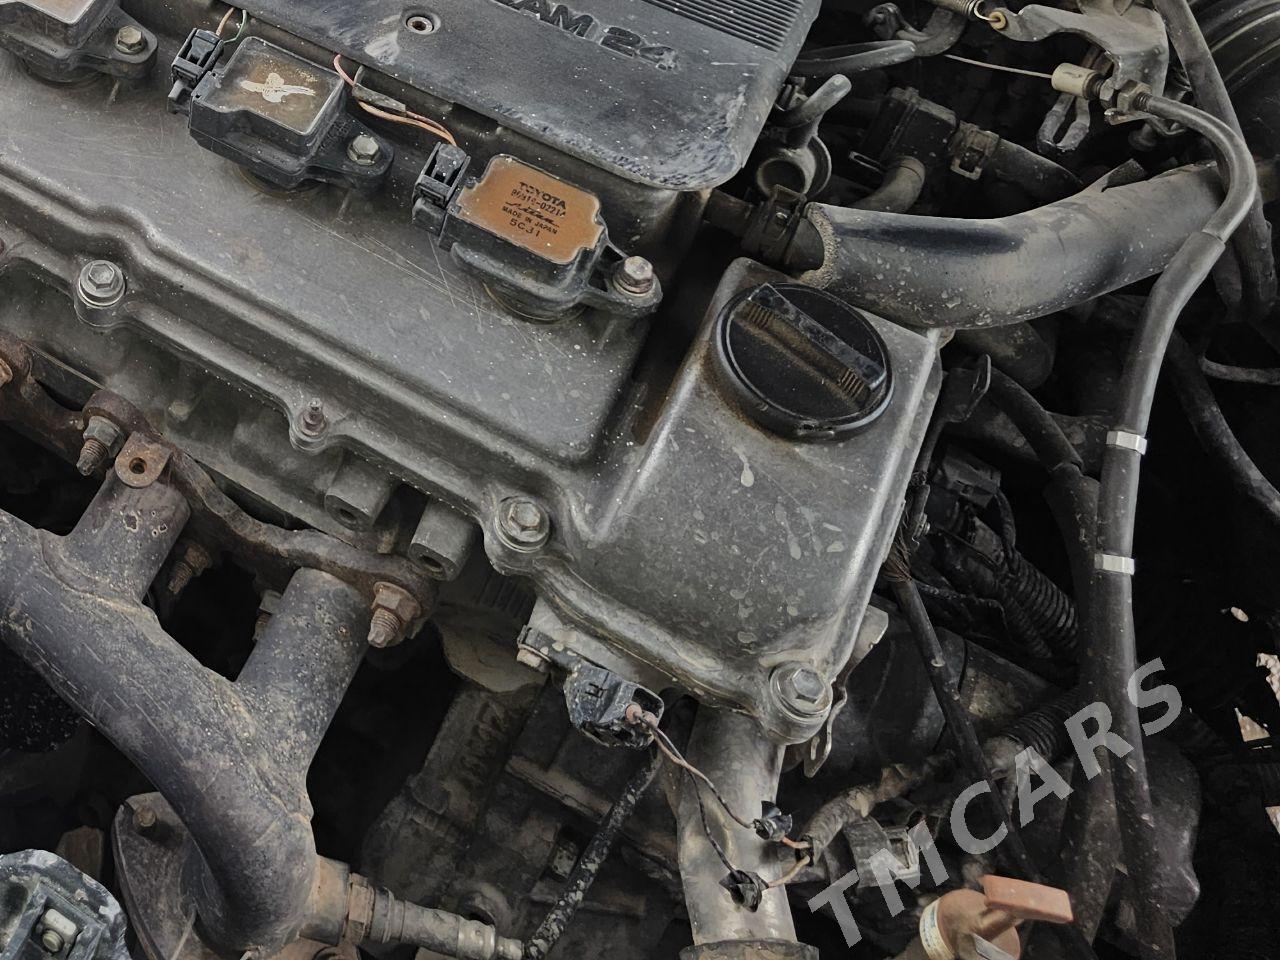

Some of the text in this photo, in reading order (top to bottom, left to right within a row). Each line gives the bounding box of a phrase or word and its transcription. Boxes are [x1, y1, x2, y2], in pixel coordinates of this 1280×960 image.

[599, 25, 679, 72] 24
[519, 181, 567, 210] TOYOTA
[501, 204, 523, 220] MADE
[533, 220, 559, 236] JAPAN
